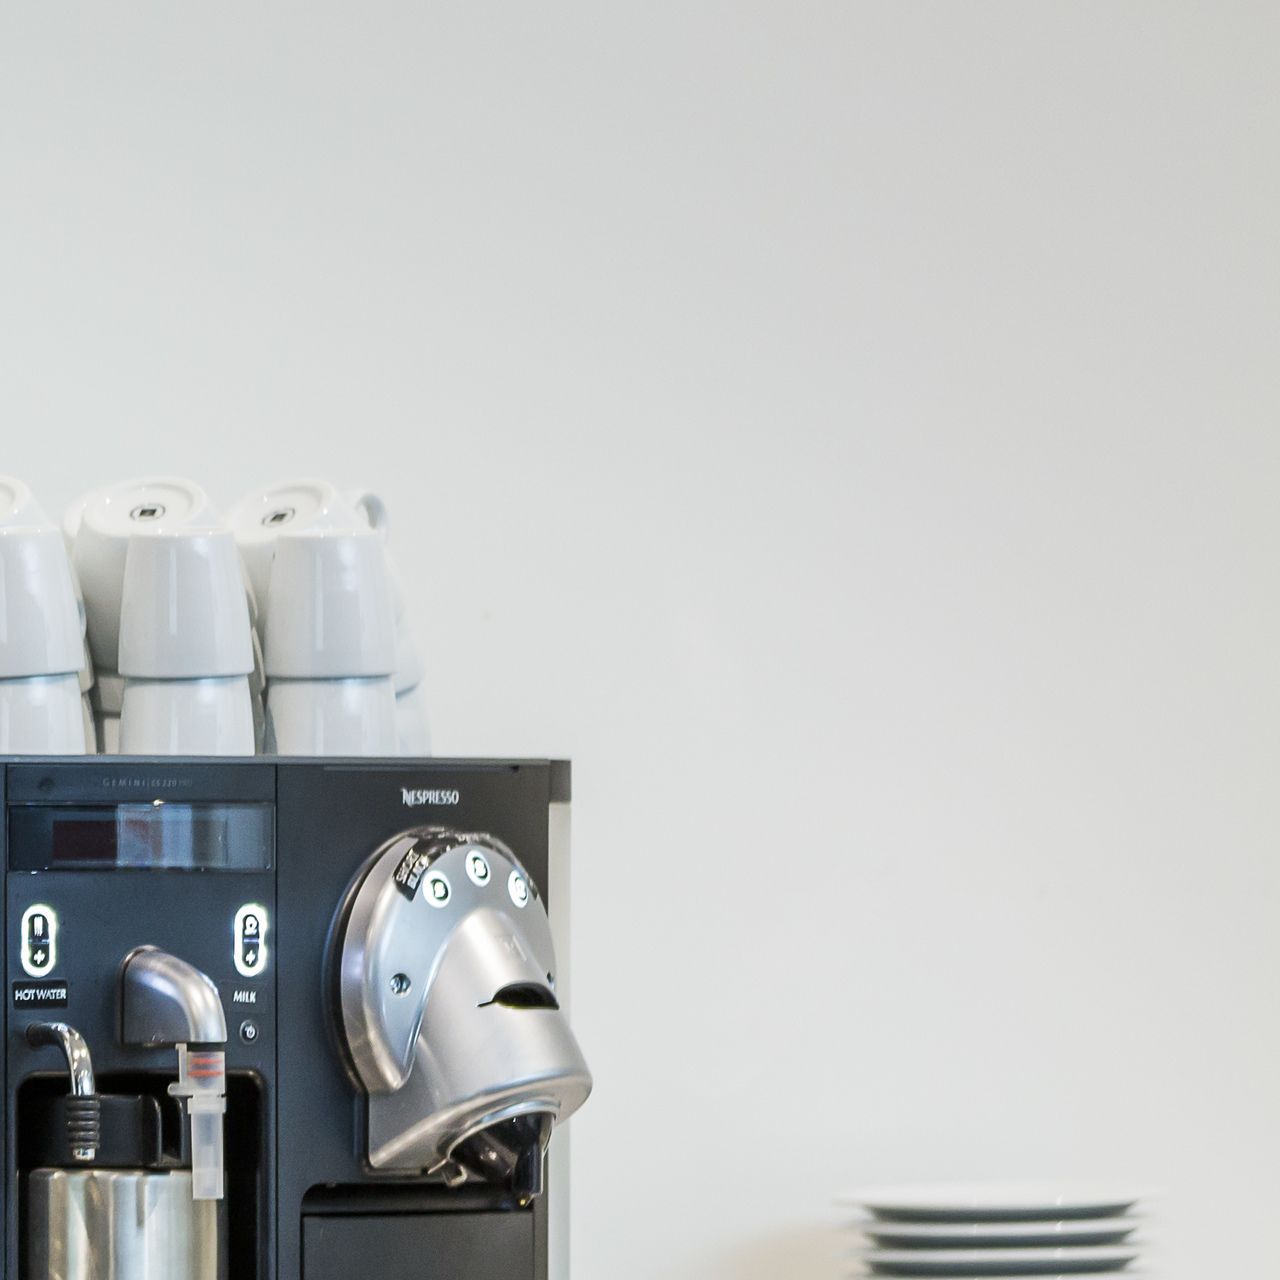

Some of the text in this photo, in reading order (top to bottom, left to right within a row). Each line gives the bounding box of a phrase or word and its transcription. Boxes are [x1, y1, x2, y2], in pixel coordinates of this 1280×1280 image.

[401, 788, 460, 807] NESPRESSO
[14, 988, 67, 1001] HOT WATER
[233, 990, 257, 1004] MILK
